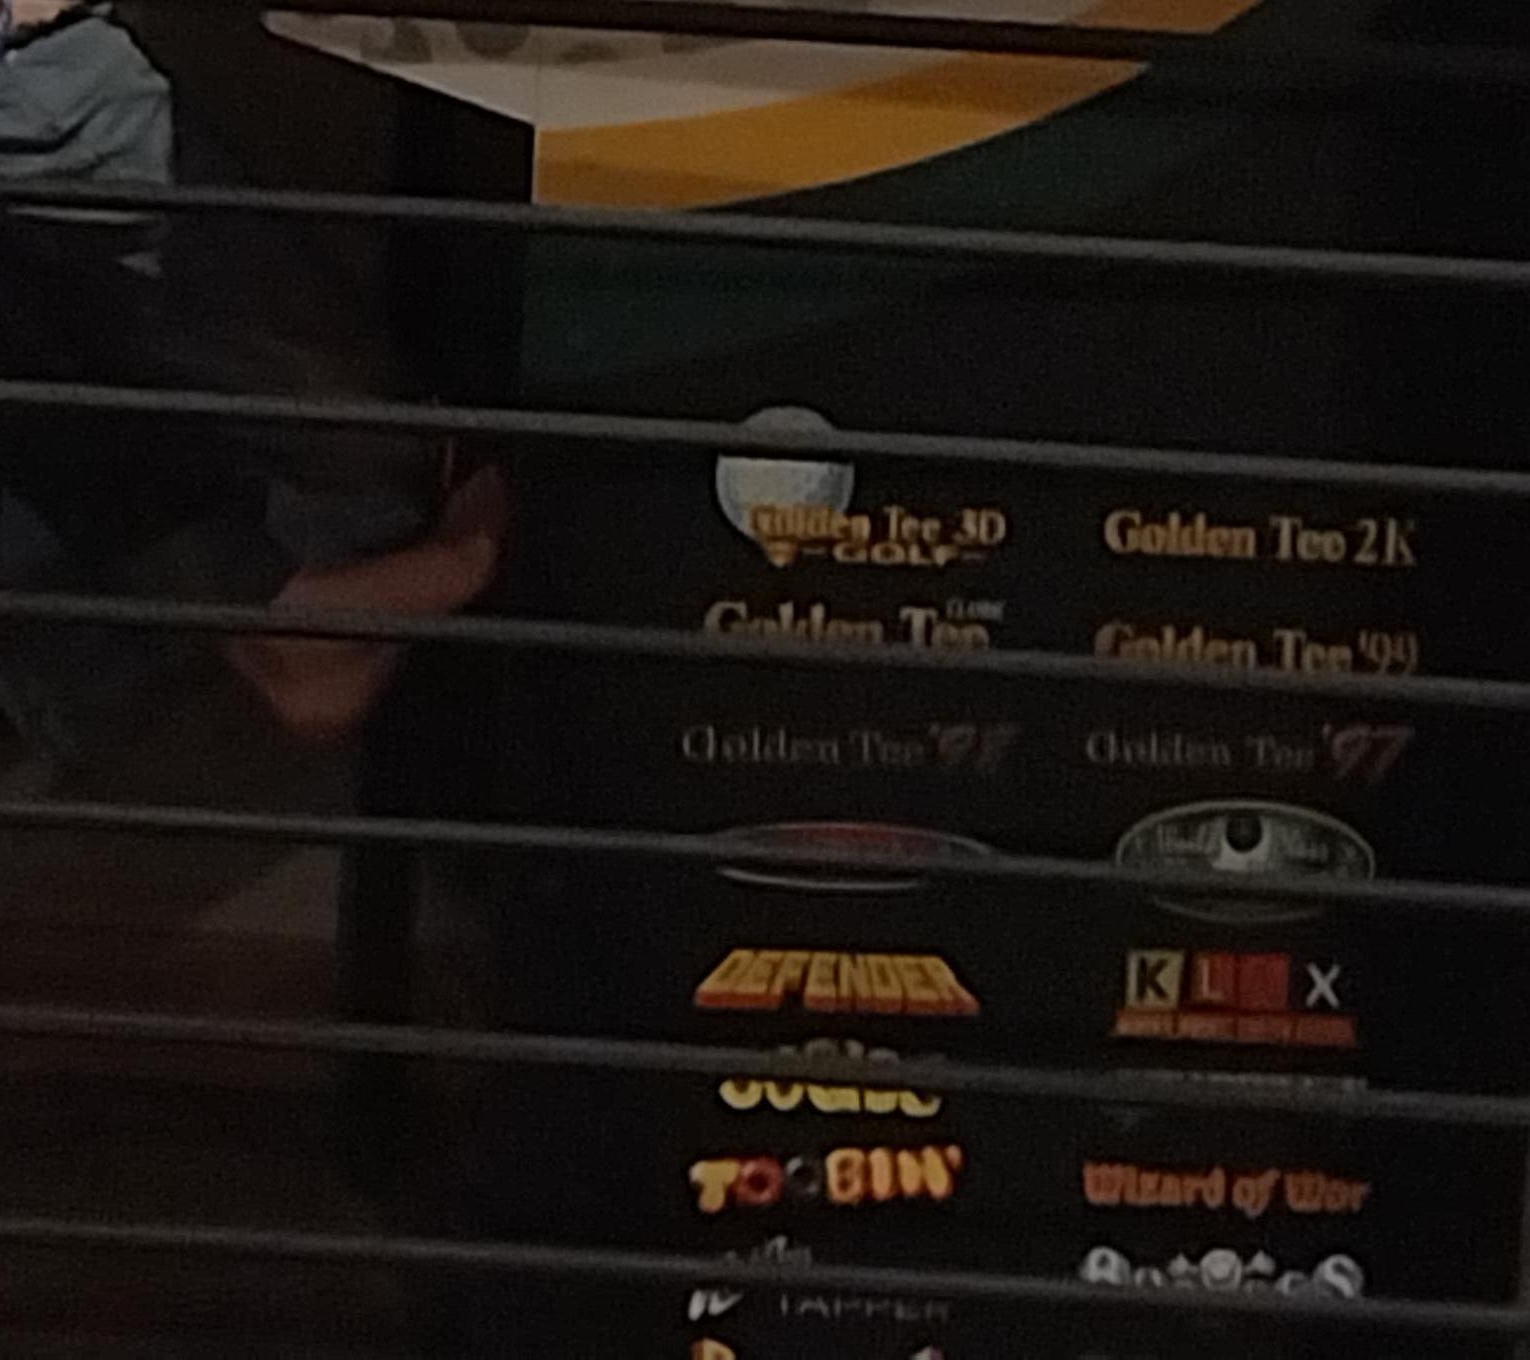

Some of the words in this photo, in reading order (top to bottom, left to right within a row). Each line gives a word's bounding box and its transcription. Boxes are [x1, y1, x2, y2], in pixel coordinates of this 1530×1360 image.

[750, 505, 872, 543] Golden
[882, 504, 943, 545] Tee
[951, 507, 1008, 547] 3D
[1102, 508, 1260, 561] Golden
[1268, 514, 1348, 564] Tee
[1352, 517, 1419, 568] 2K
[830, 540, 958, 568] GOLF
[703, 599, 885, 646] Golden
[1092, 620, 1259, 671] Golden
[1272, 628, 1355, 674] Tee
[1357, 628, 1420, 677] '99
[681, 723, 841, 765] Golden
[849, 729, 928, 766] Tee
[1084, 729, 1232, 766] Golden
[1244, 733, 1316, 770] Tee
[692, 947, 982, 1017] DEFENDER
[1081, 1159, 1226, 1209] Wizard
[1232, 1166, 1281, 1220] of
[1283, 1170, 1373, 1215] Wor
